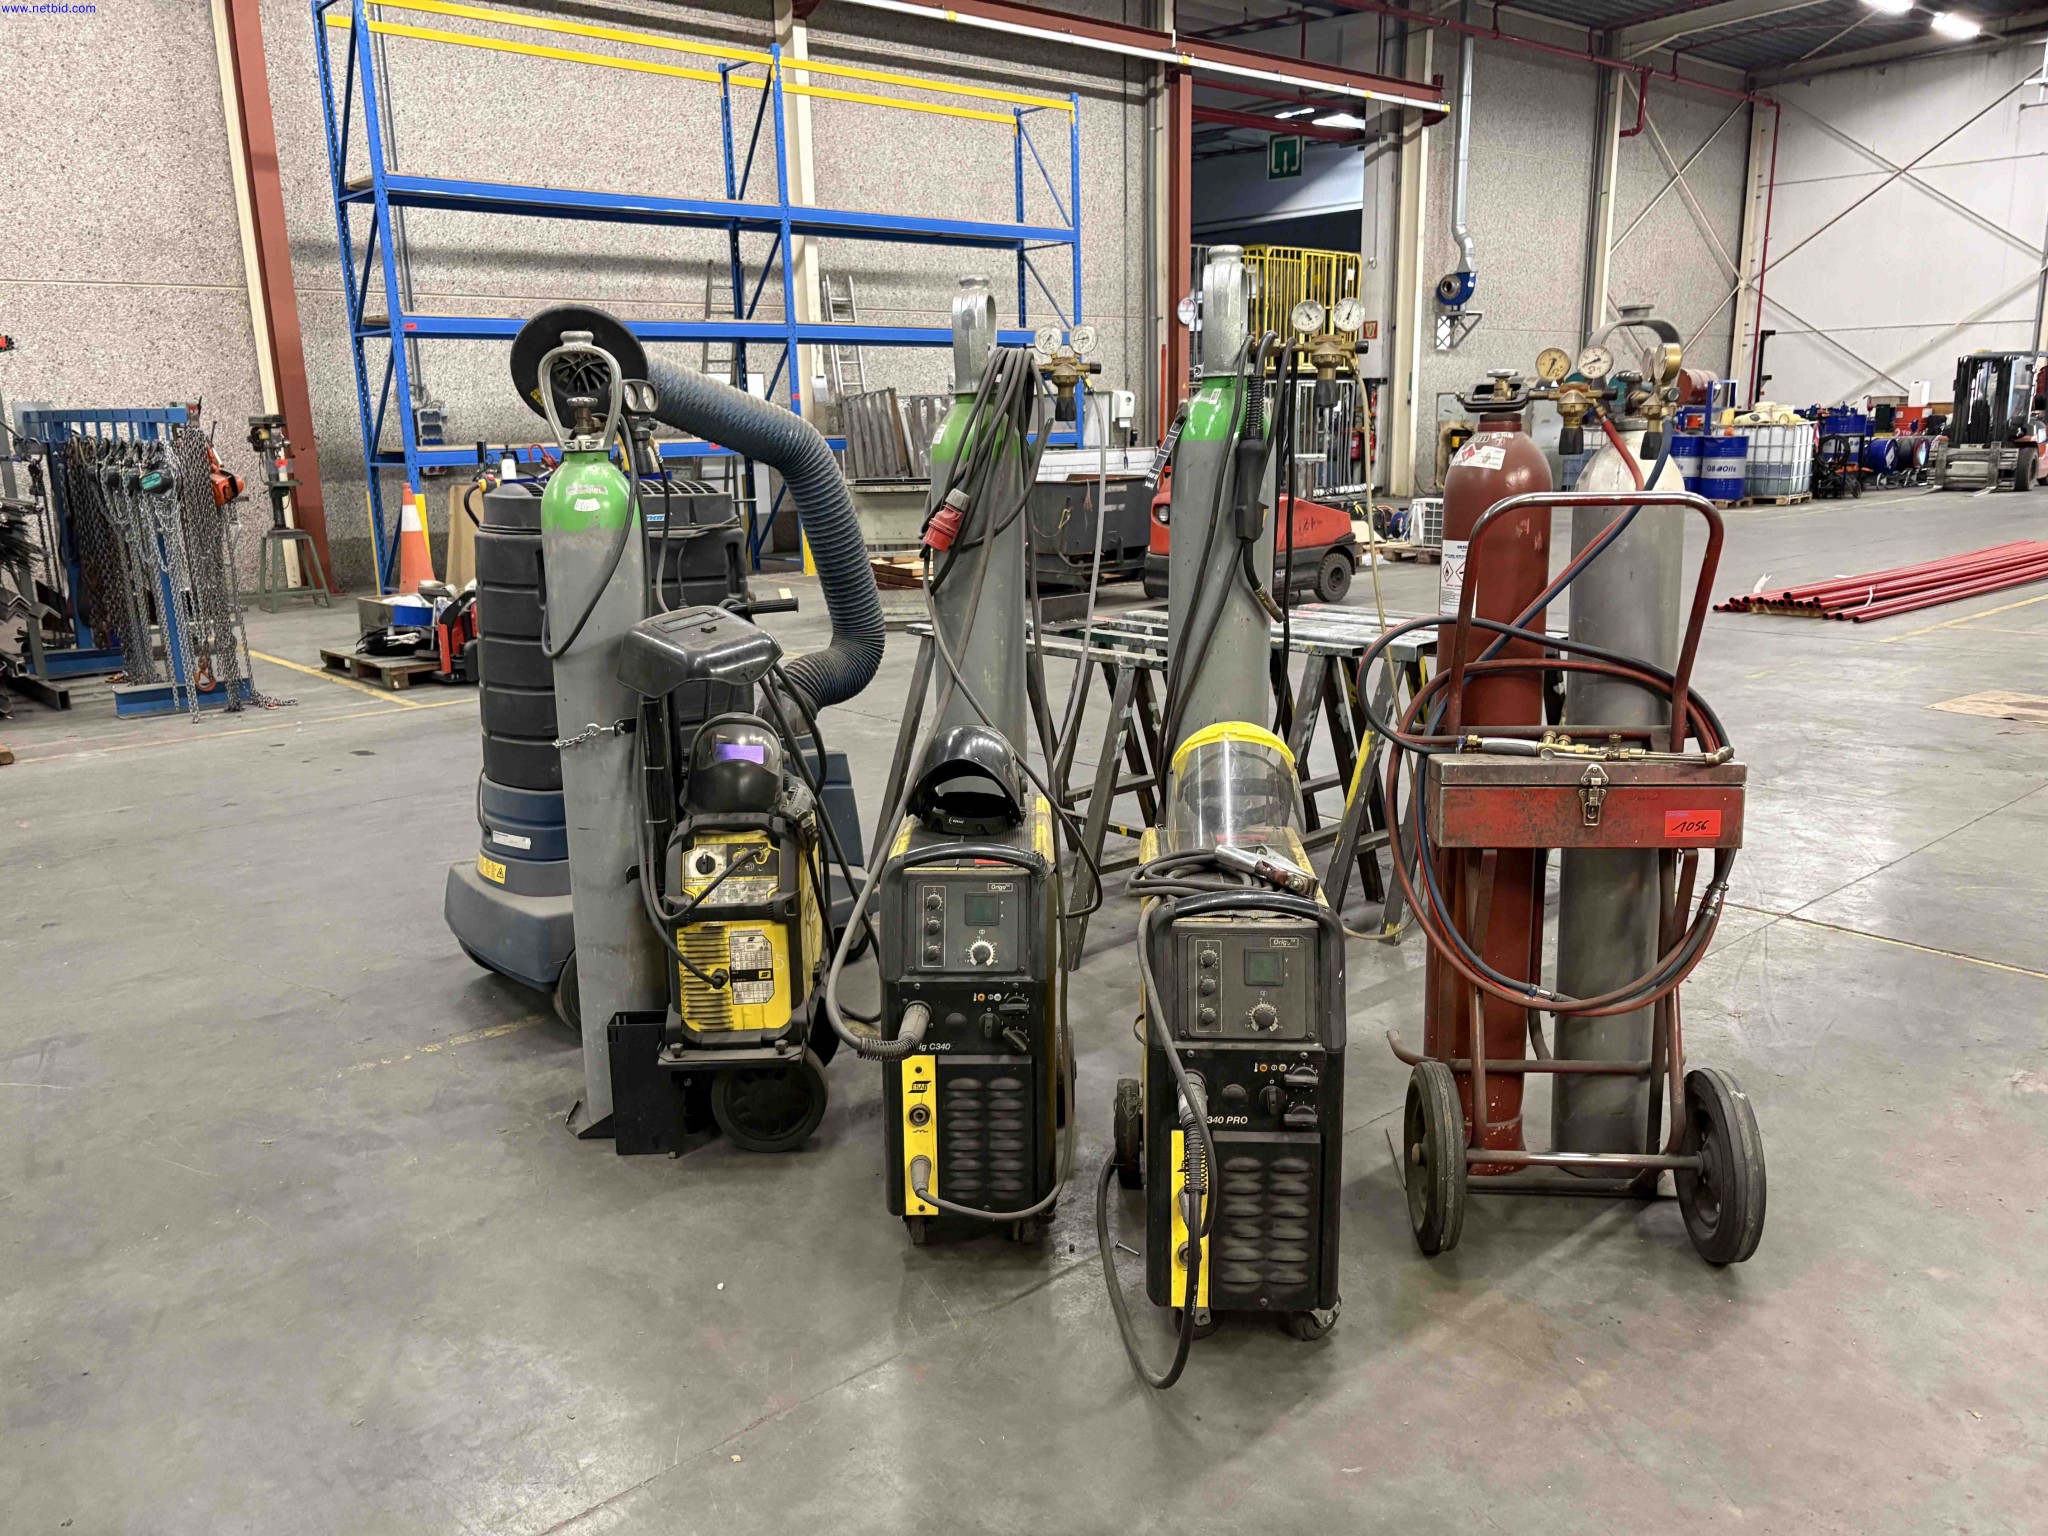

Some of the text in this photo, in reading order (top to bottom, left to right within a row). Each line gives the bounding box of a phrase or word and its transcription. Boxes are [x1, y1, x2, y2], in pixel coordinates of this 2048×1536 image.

[1672, 819, 1710, 833] 1056
[918, 1042, 951, 1051] ig C340
[1206, 1115, 1249, 1125] 340 PRO
